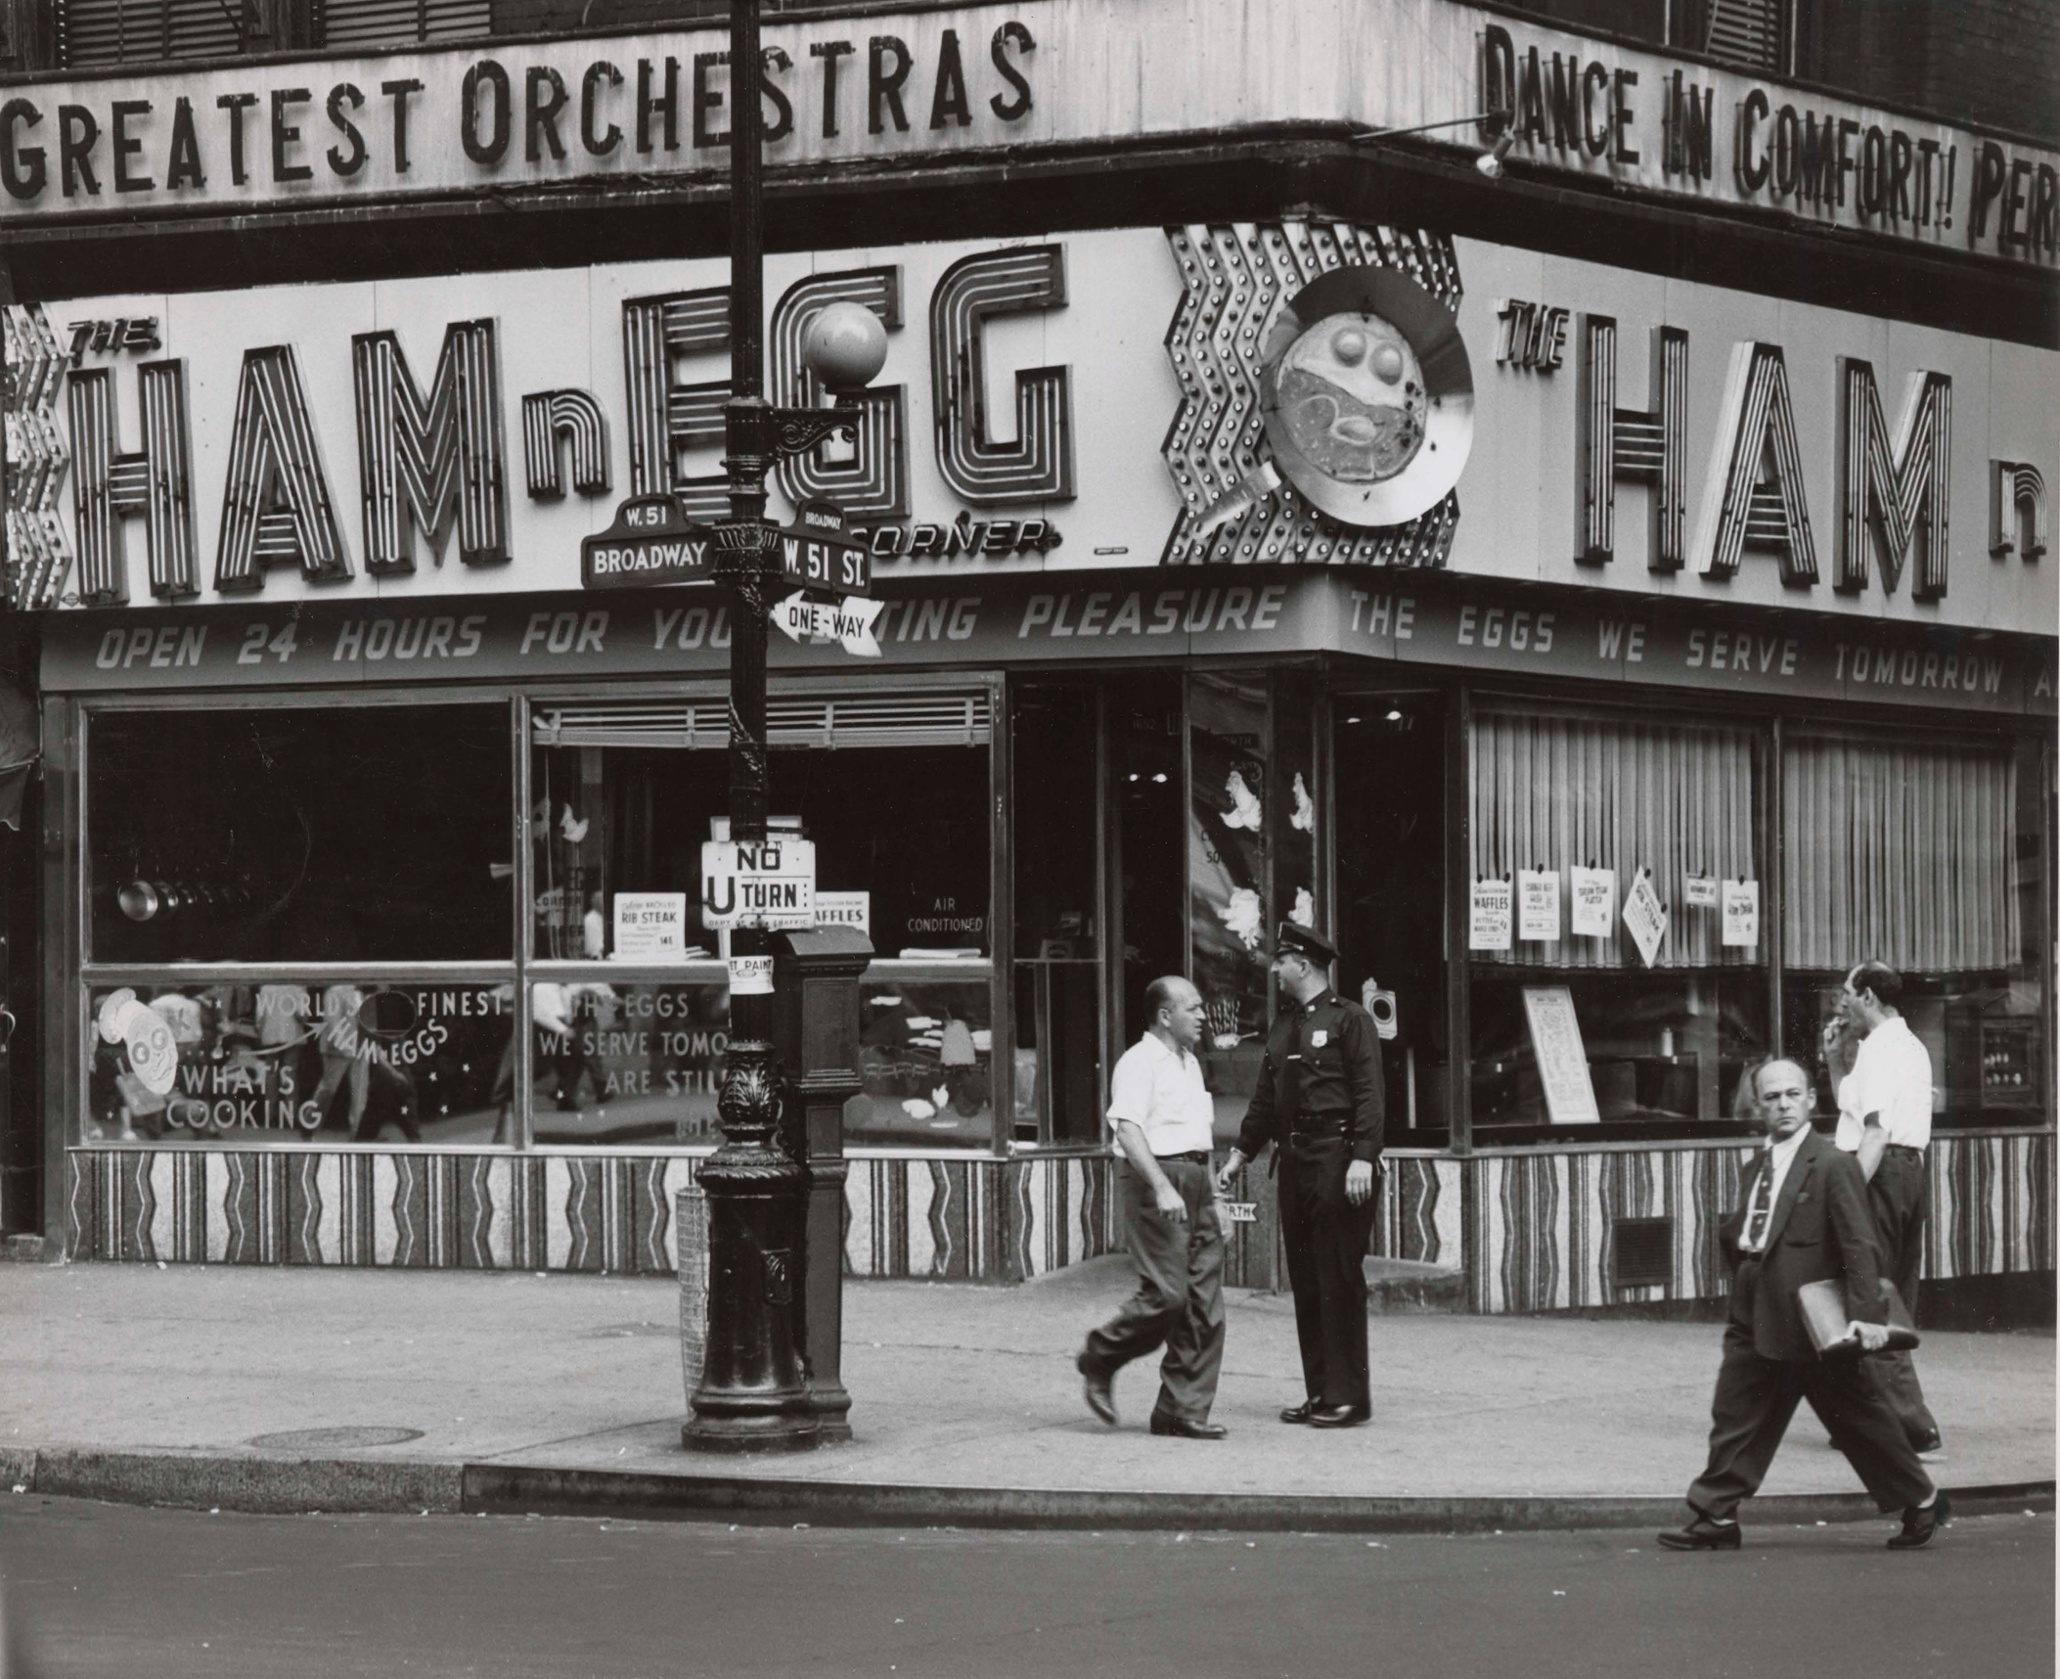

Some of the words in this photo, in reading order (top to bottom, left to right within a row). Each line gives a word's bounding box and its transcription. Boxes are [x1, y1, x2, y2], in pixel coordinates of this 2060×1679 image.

[1, 80, 424, 198] GREATEST
[461, 21, 1036, 164] ORCHESTRAS
[1484, 24, 1640, 165] DANCE
[1664, 68, 1714, 181] IN
[1743, 88, 1957, 230] COMFORT!
[67, 317, 162, 366] THE
[1498, 298, 1570, 371] THE
[67, 316, 513, 606] HAM
[622, 242, 1077, 520] EGG
[1575, 312, 1953, 602] HAM
[626, 510, 642, 526] W.
[646, 506, 667, 525] 51
[805, 511, 842, 531] BROADWAY
[594, 541, 708, 574] BROADWAY
[783, 536, 801, 576] W.
[807, 543, 831, 582] 51
[842, 549, 866, 588] ST.
[96, 625, 207, 669] OPEN
[237, 622, 299, 665] 24
[333, 615, 487, 661] HOURS
[520, 609, 609, 655] FOR
[654, 607, 732, 650] YOU
[1018, 585, 1288, 638] PLEASURE
[1351, 590, 1415, 640] THE
[1457, 605, 1556, 654] EGGS
[1599, 618, 1646, 663] WE
[1686, 628, 1799, 676] SERVE
[1836, 643, 2004, 693] TOMORROW
[736, 847, 781, 871] NO
[707, 876, 736, 915] U
[741, 883, 798, 908] TURN
[934, 898, 956, 911] AIR
[1474, 896, 1509, 910] WAFFLES
[622, 911, 638, 924] RIB
[642, 911, 678, 925] STEAK
[815, 909, 863, 922] AFFLES
[907, 918, 983, 933] CONDITIONED
[745, 960, 773, 971] PAINT
[418, 992, 502, 1016] FINEST
[625, 993, 689, 1018] EGGS
[391, 1018, 449, 1066] EGGS
[539, 1031, 572, 1056] WE
[583, 1031, 649, 1056] SERVE
[182, 1065, 295, 1096] WHAT'S
[604, 1070, 650, 1094] ARE
[167, 1099, 322, 1129] COOKING
